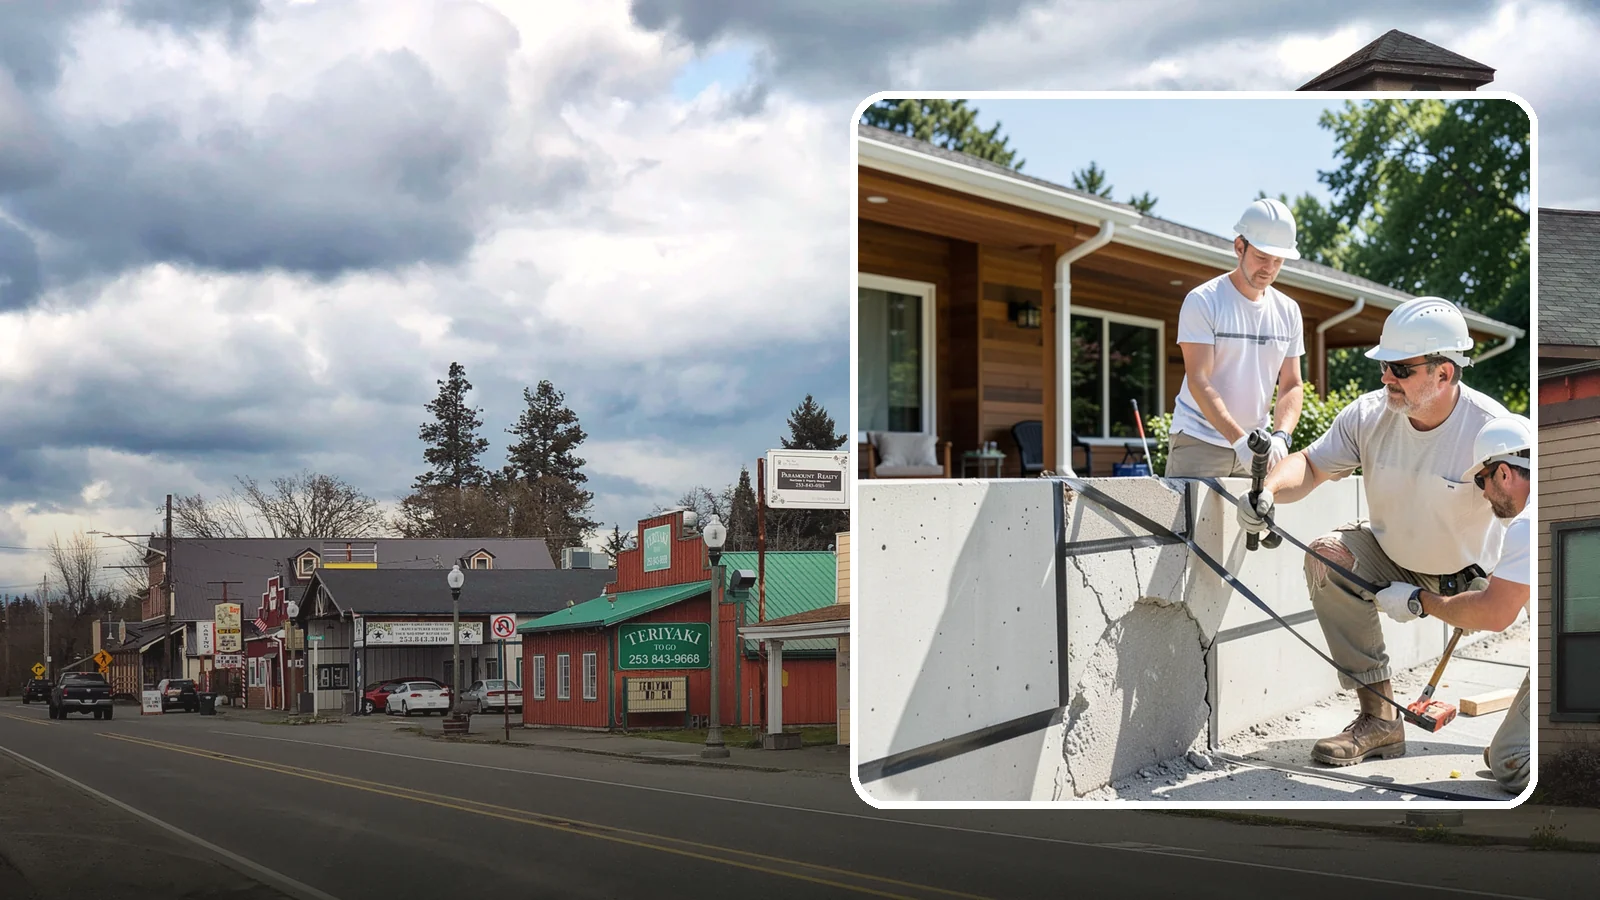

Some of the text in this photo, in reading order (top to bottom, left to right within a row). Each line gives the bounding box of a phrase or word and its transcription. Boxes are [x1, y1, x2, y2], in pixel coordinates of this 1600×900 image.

[624, 627, 702, 646] TERIYAKI
[629, 654, 700, 665] 253 843-9668
